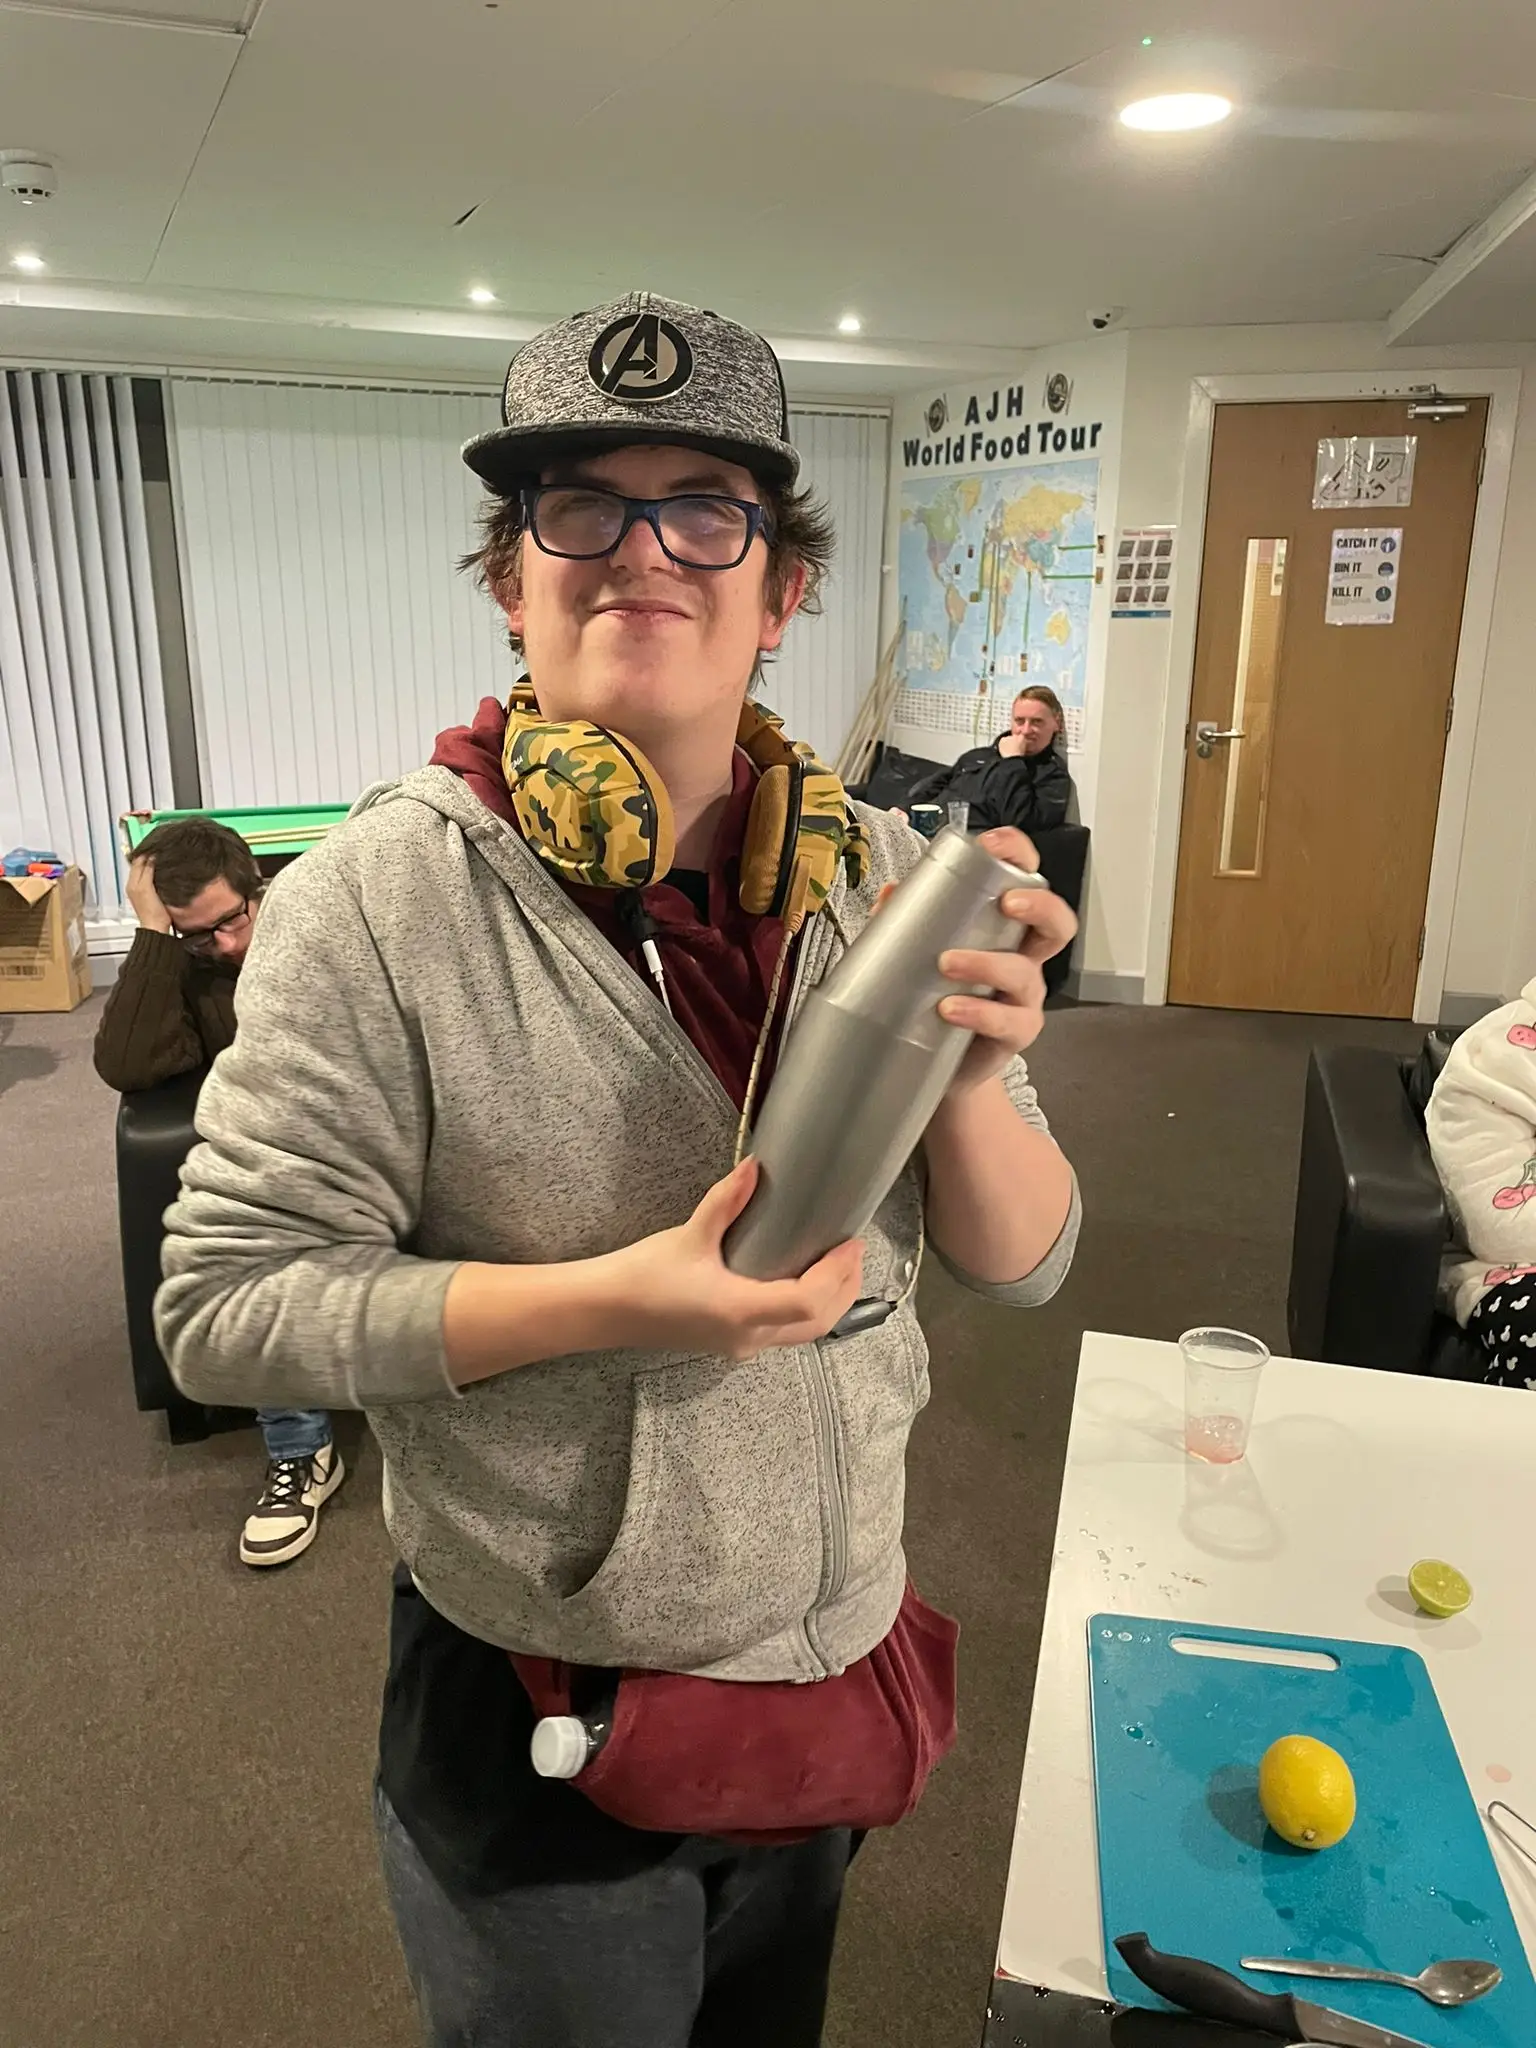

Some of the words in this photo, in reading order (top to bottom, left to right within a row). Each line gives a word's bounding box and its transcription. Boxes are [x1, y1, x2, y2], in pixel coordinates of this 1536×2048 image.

[964, 385, 1023, 426] AJH
[903, 434, 965, 467] World
[970, 424, 1031, 461] Food
[1037, 421, 1102, 453] Tour
[1336, 538, 1366, 549] CATCH
[1369, 537, 1378, 548] IT
[1334, 562, 1350, 573] BIN
[1352, 562, 1362, 573] IT
[1332, 586, 1351, 598] KILL
[1353, 586, 1363, 597] IT
